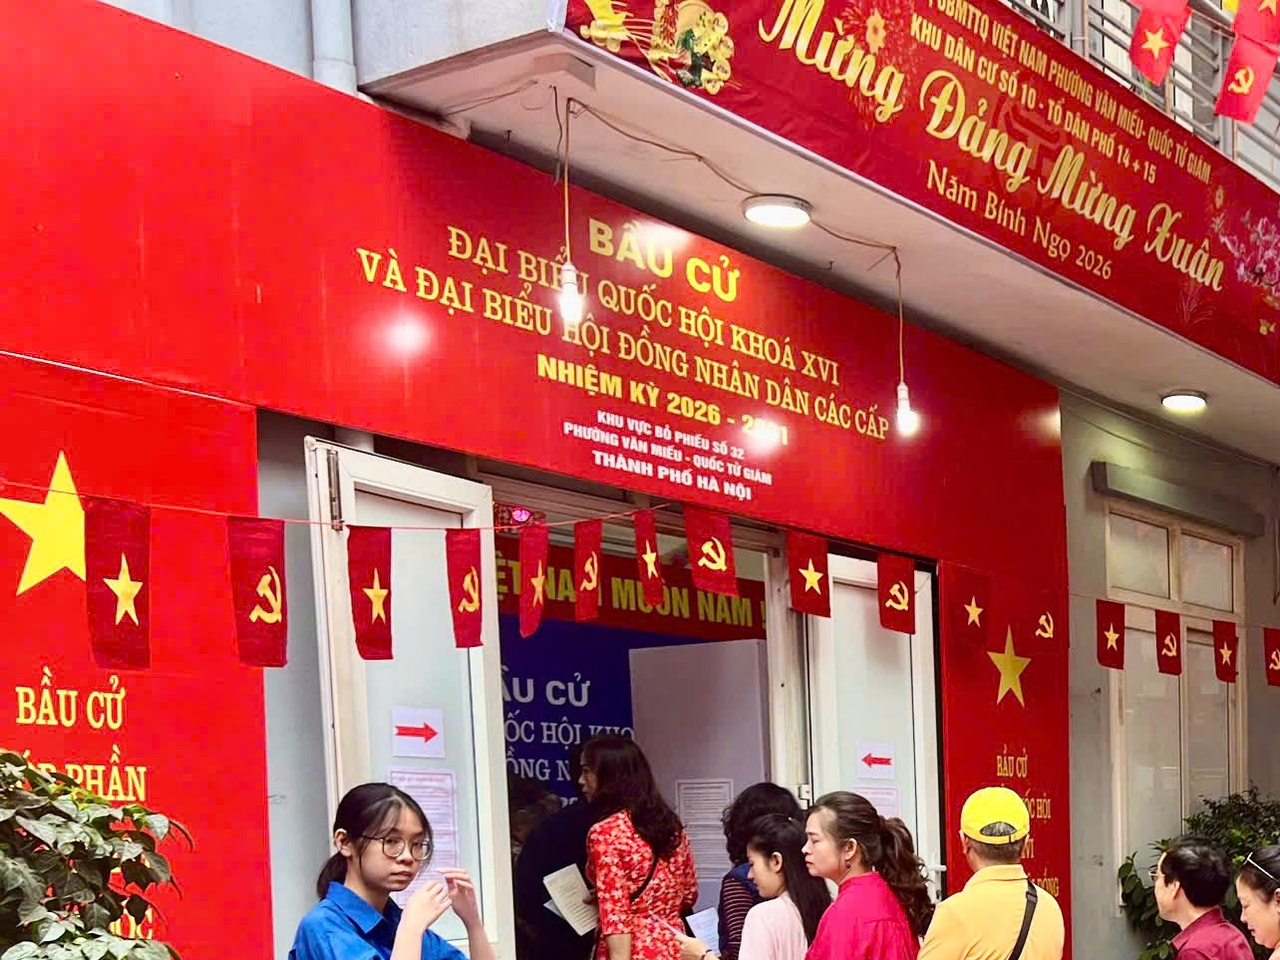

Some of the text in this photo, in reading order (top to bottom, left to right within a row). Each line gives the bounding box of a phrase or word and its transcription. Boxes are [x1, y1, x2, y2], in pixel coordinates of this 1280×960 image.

[910, 12, 942, 51] KHU
[944, 35, 975, 73] DÂN
[976, 56, 999, 86] CƯ
[999, 66, 1018, 98] SỐ
[1021, 84, 1037, 110] 10
[1048, 96, 1064, 126] TỔ
[1064, 110, 1090, 145] DÂN
[1091, 129, 1116, 158] PHỐ
[1117, 144, 1130, 170] 14
[1132, 162, 1140, 173] +
[1142, 161, 1156, 185] 15
[992, 21, 1018, 59] VIỆT
[1018, 39, 1047, 77] NAM
[1049, 60, 1093, 109] PHƯỜNG
[1095, 85, 1117, 127] VĂN
[1148, 126, 1174, 160] QUỐC
[1187, 150, 1212, 185] GIÁM
[758, 0, 1226, 292] Mừng Đảng Mừng Xuân
[927, 159, 977, 212] Năm
[1032, 216, 1072, 262] Ngọ
[1075, 244, 1112, 280] 2026
[447, 225, 509, 275] ĐẠI
[598, 277, 672, 328] QUỐC
[678, 305, 724, 347] HỘI
[730, 324, 794, 372] KHOÁ
[801, 349, 840, 387] XVI
[686, 254, 741, 303] CỬ
[356, 247, 890, 441] VÀ ĐẠI BIỂU HỘI ĐỒNG NHÂN DÂN CÁC CẤP
[537, 354, 623, 399] NHIỆM
[666, 392, 721, 427] 2026
[563, 421, 619, 447] PHƯỜNG
[622, 434, 648, 453] VĂN
[651, 442, 683, 463] MIẾU
[693, 452, 725, 473] QUỐC
[744, 464, 772, 486] GIÁM
[597, 410, 624, 429] KHU
[627, 417, 652, 437] VỰC
[675, 430, 710, 451] PHIẾU
[712, 436, 728, 456] SỐ
[730, 445, 745, 460] 32
[592, 449, 752, 502] THÀNH PHỐ HÀ NỘI
[15, 666, 126, 730] BẦU CỬ
[545, 672, 591, 707] CỬ
[540, 715, 582, 751] HỘI
